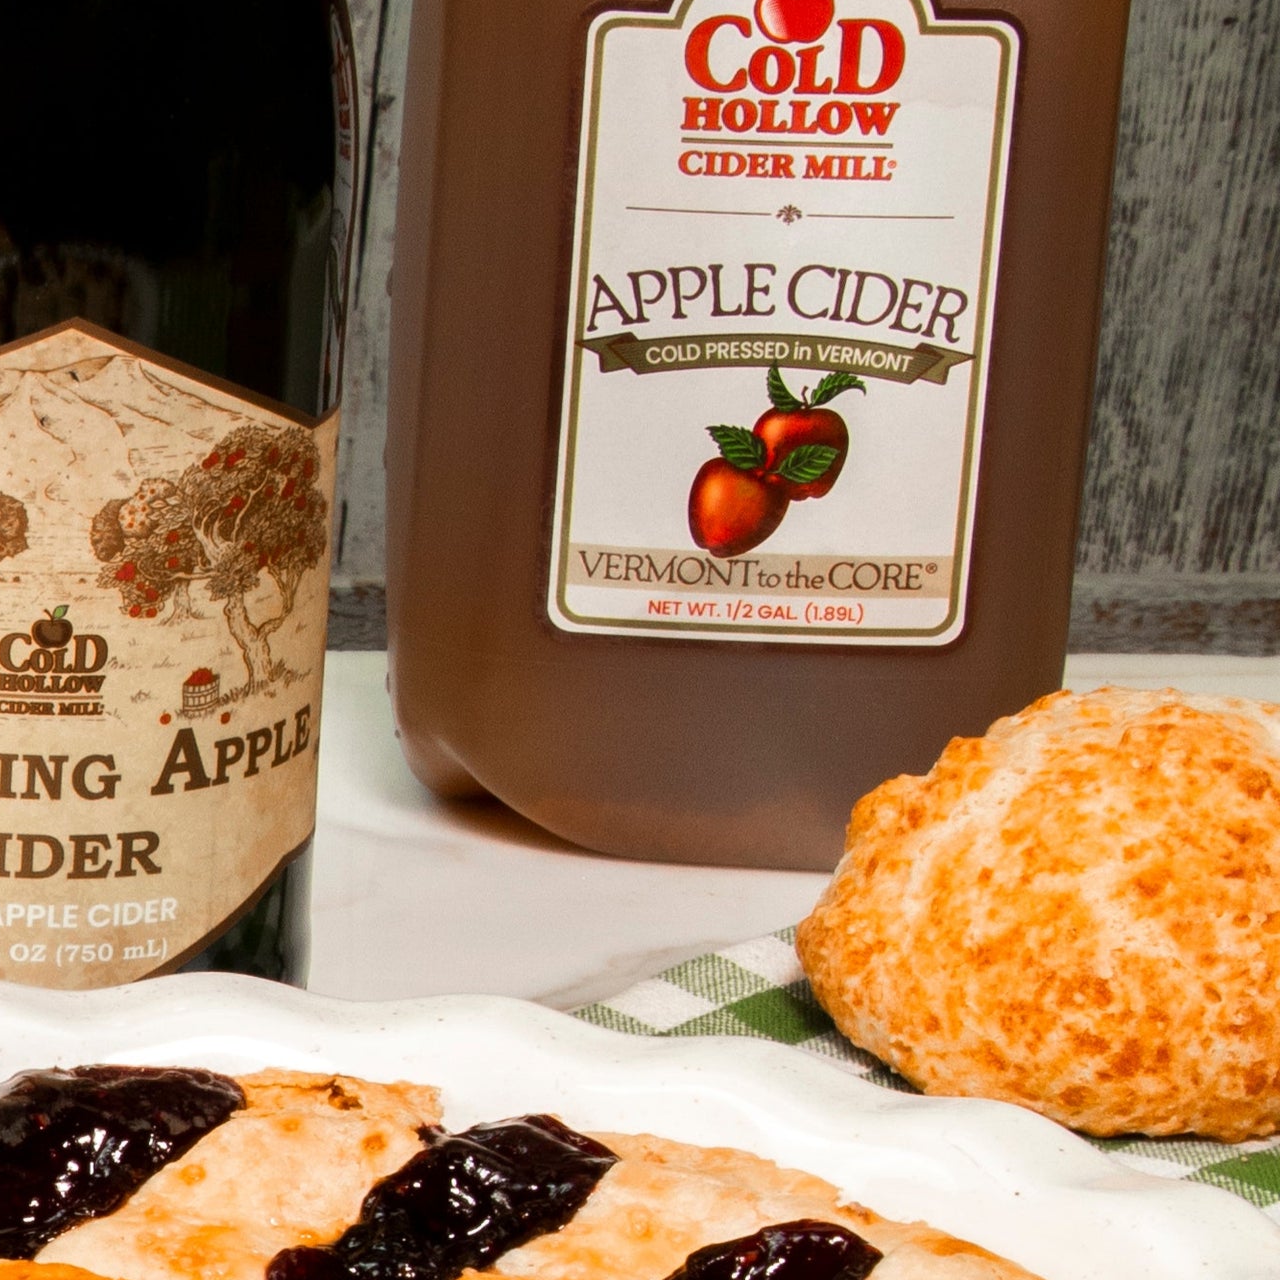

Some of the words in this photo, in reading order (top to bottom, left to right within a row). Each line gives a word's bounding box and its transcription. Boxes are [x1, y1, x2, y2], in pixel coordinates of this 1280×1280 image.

[684, 16, 906, 98] COLD
[681, 96, 900, 136] HOLLOW
[678, 150, 793, 180] CIDER
[587, 264, 776, 332] APPLE
[787, 264, 969, 344] CIDER
[645, 342, 700, 365] COLD
[704, 340, 790, 362] PRESSED
[793, 340, 811, 361] in
[815, 343, 915, 374] VERMONT
[579, 551, 759, 588] VERMONT
[757, 569, 782, 589] to
[786, 566, 825, 591] the
[648, 600, 686, 618] NET
[689, 600, 720, 619] WT.
[726, 602, 753, 621] 1/2
[804, 602, 865, 625] (1.89L)
[150, 704, 311, 795] APPLE
[86, 897, 179, 927] CIDER
[10, 940, 47, 962] OZ
[56, 942, 114, 965] (750
[123, 937, 169, 960] mL)
